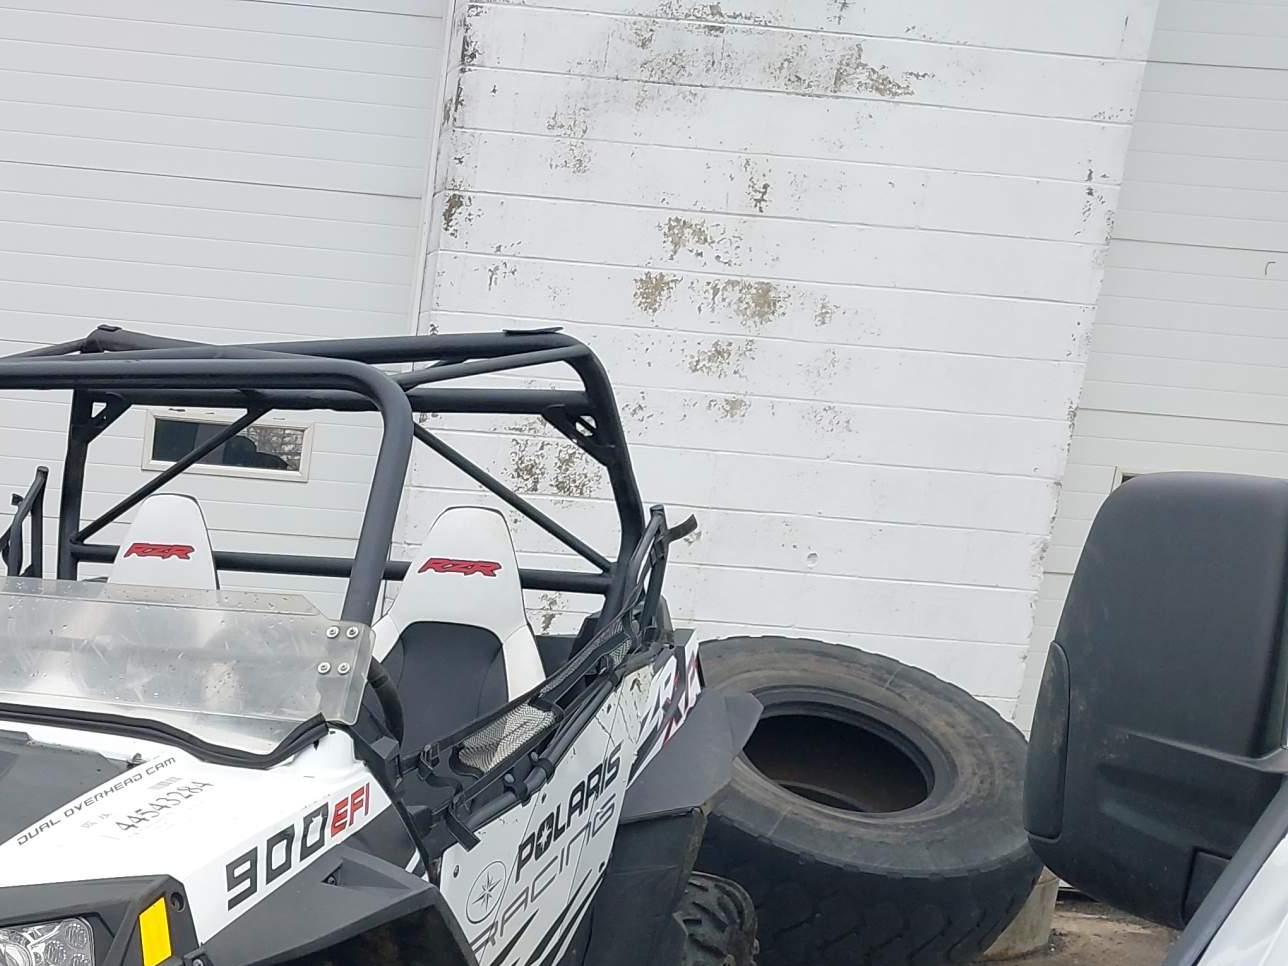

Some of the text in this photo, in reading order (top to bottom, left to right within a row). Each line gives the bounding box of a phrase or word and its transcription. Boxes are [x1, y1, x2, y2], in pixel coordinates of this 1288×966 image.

[123, 542, 195, 560] RZR
[417, 557, 502, 577] RZR
[16, 818, 62, 846] DUAL
[63, 772, 143, 818] OVERHEAD
[145, 756, 177, 776] CAM
[515, 739, 623, 884] POLARIS
[469, 792, 616, 955] RACING
